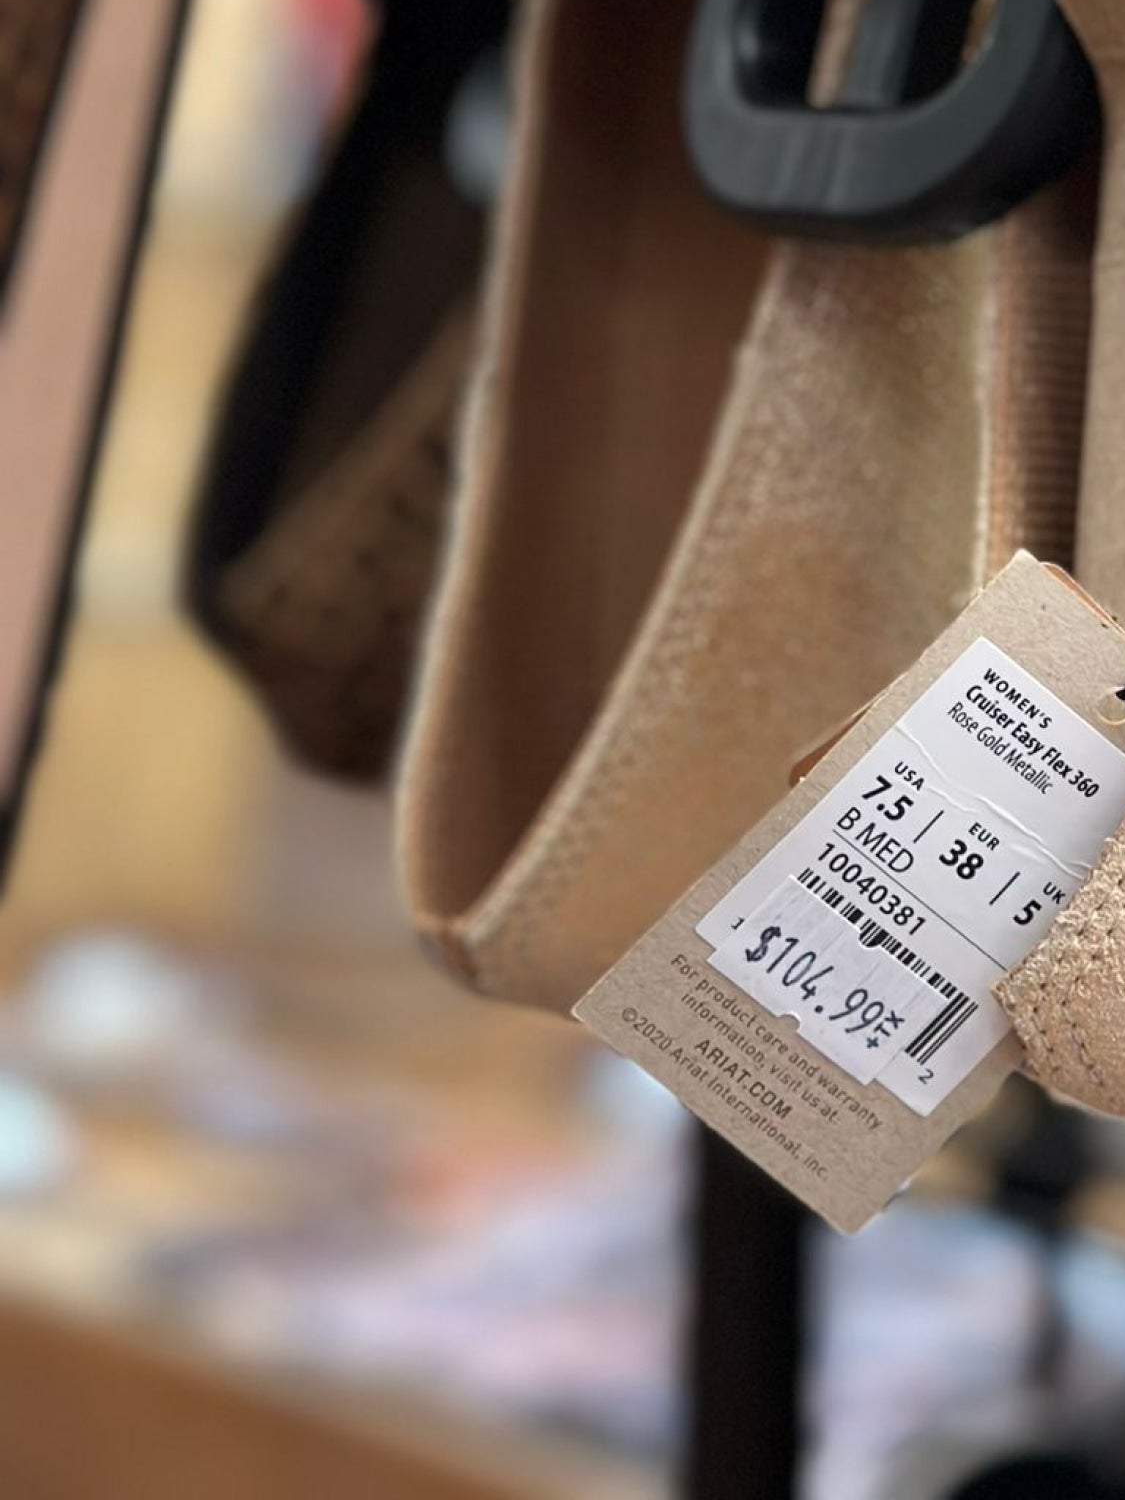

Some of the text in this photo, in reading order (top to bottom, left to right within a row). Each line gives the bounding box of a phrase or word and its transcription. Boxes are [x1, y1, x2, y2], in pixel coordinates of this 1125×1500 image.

[983, 667, 1053, 729] WOMEN'S
[946, 700, 1054, 796] Rose Gold Metallic
[965, 684, 1101, 799] Cruiser Easy Flex 360
[861, 774, 915, 822] 7.5
[893, 761, 926, 791] USA
[836, 806, 915, 874] B MED
[938, 838, 984, 881] 38
[967, 821, 1001, 851] EUR
[816, 841, 927, 937] 10040381
[1012, 899, 1043, 926] 5
[1042, 881, 1067, 906] UK
[744, 925, 885, 1035] $104.99
[668, 1046, 710, 1082] Ariat
[670, 953, 883, 1132] For product care and warranty
[680, 992, 767, 1070] information,
[769, 1062, 801, 1093] visit
[801, 1089, 821, 1109] us
[694, 1038, 793, 1121] ARIAT.COM
[917, 1067, 935, 1086] 2
